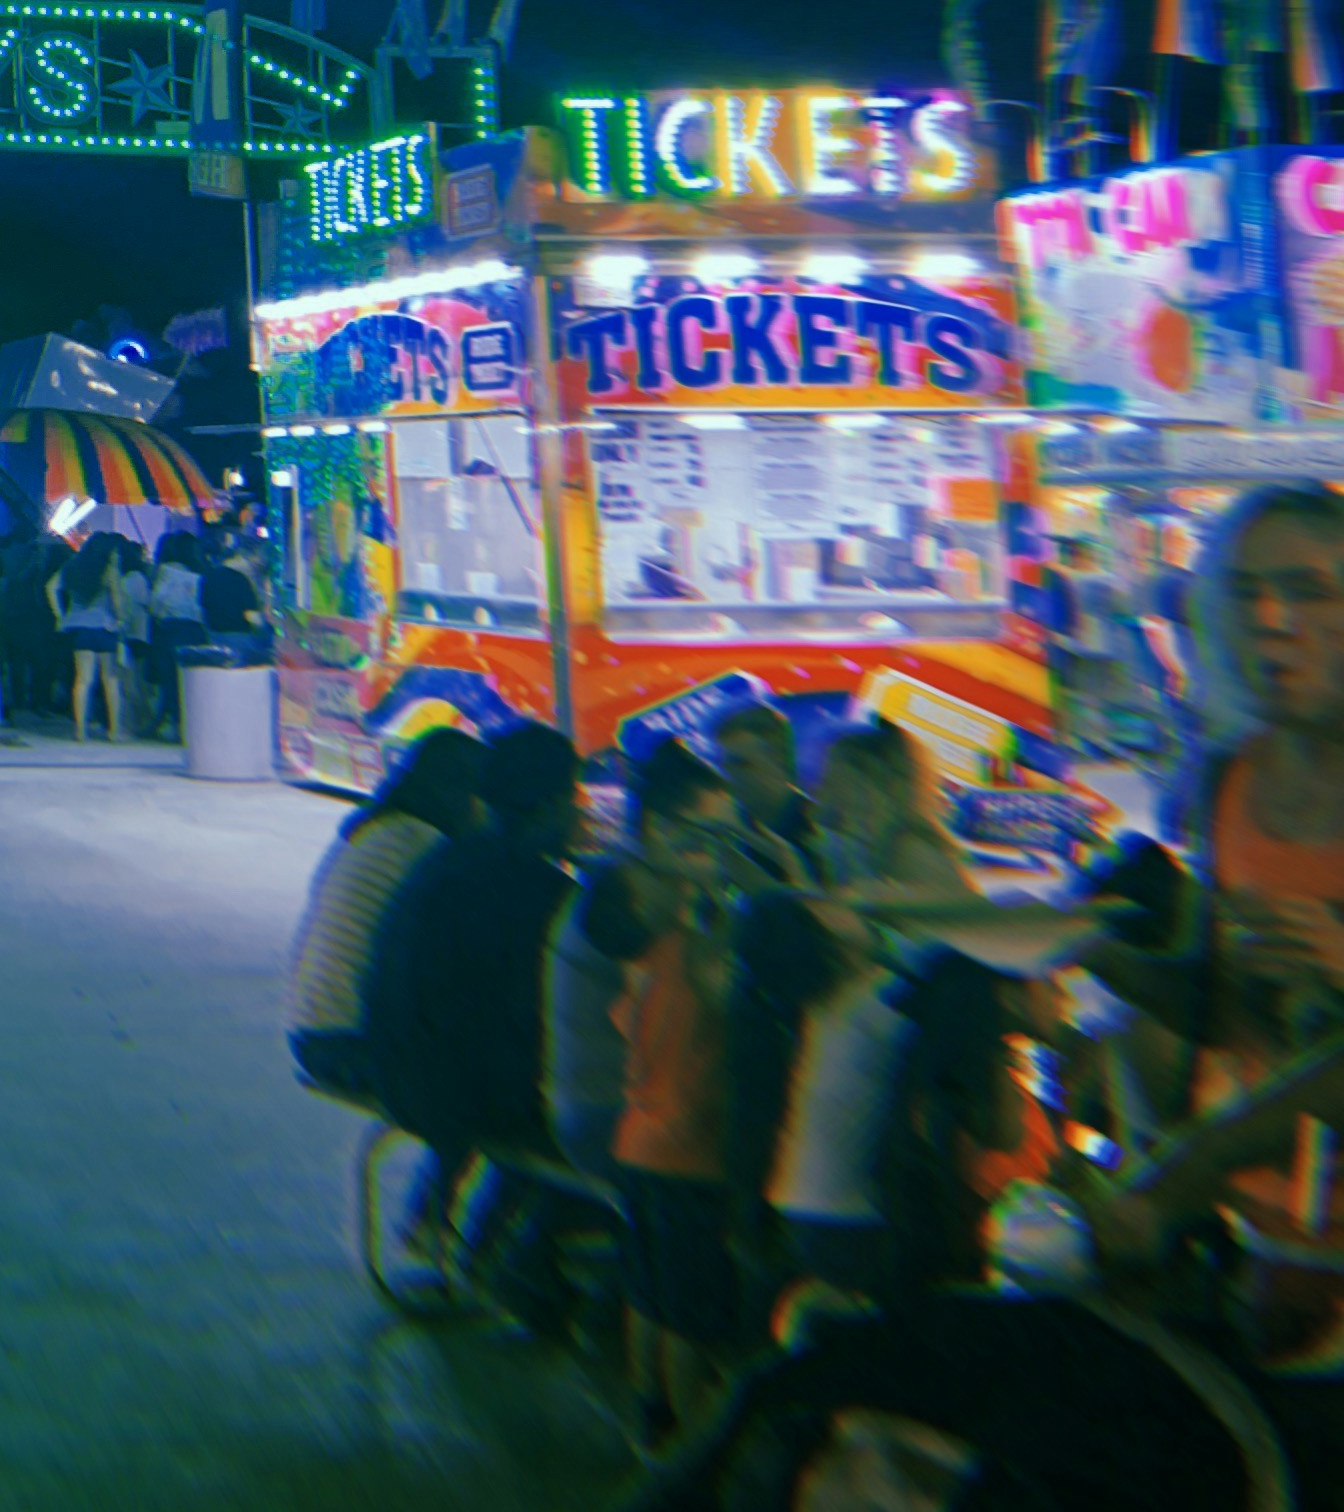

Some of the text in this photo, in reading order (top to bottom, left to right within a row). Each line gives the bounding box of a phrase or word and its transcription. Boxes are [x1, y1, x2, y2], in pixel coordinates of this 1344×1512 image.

[304, 135, 424, 240] TICKETS
[561, 95, 977, 196] TICKETS
[565, 293, 979, 394] TICKETS
